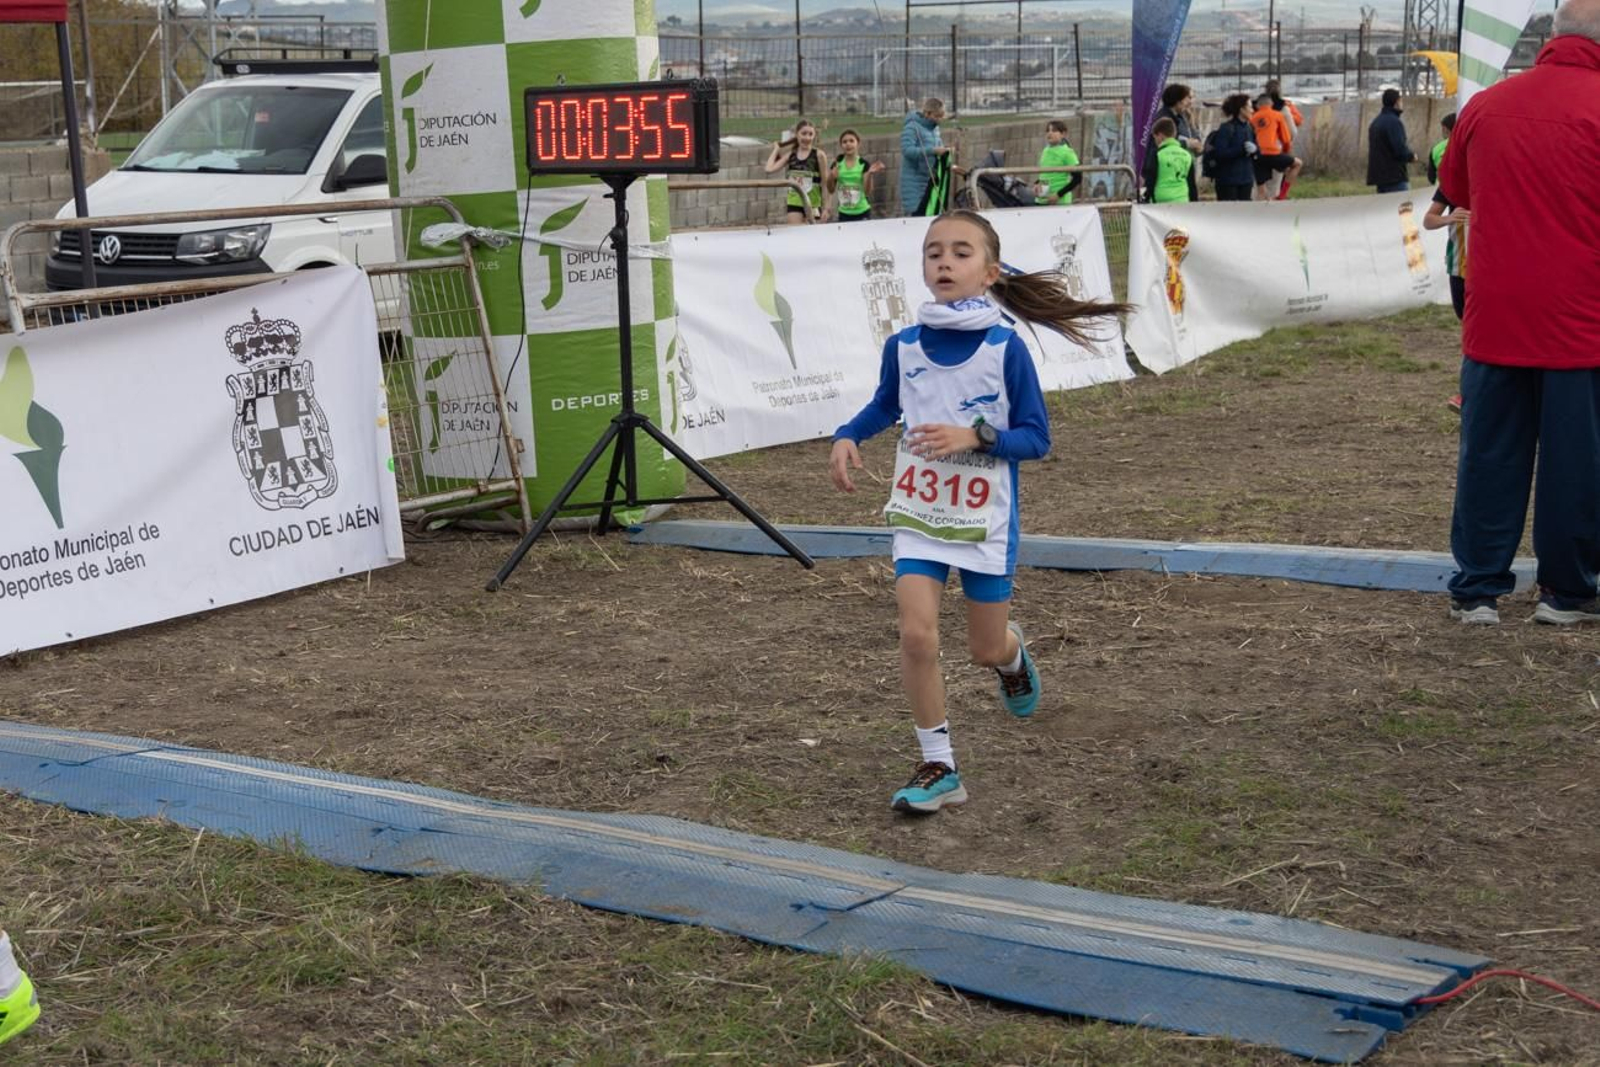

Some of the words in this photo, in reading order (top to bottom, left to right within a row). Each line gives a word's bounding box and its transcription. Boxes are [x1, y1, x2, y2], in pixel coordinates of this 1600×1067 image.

[418, 111, 497, 130] DIPUTACIÓN
[535, 94, 690, 161] 00:03:55
[420, 135, 435, 148] DE
[436, 131, 469, 148] JAÉN
[567, 269, 588, 283] DE
[441, 401, 518, 415] DPUTACIN
[551, 388, 650, 411] DEPORES
[697, 406, 727, 428] JAÉN
[895, 464, 991, 510] 4319
[54, 524, 135, 560] Municipal
[138, 521, 161, 543] de
[228, 523, 304, 557] CIUDAD
[306, 516, 333, 540] DE
[336, 503, 381, 534] JAÉN
[77, 560, 101, 582] de
[104, 550, 147, 576] Jaén
